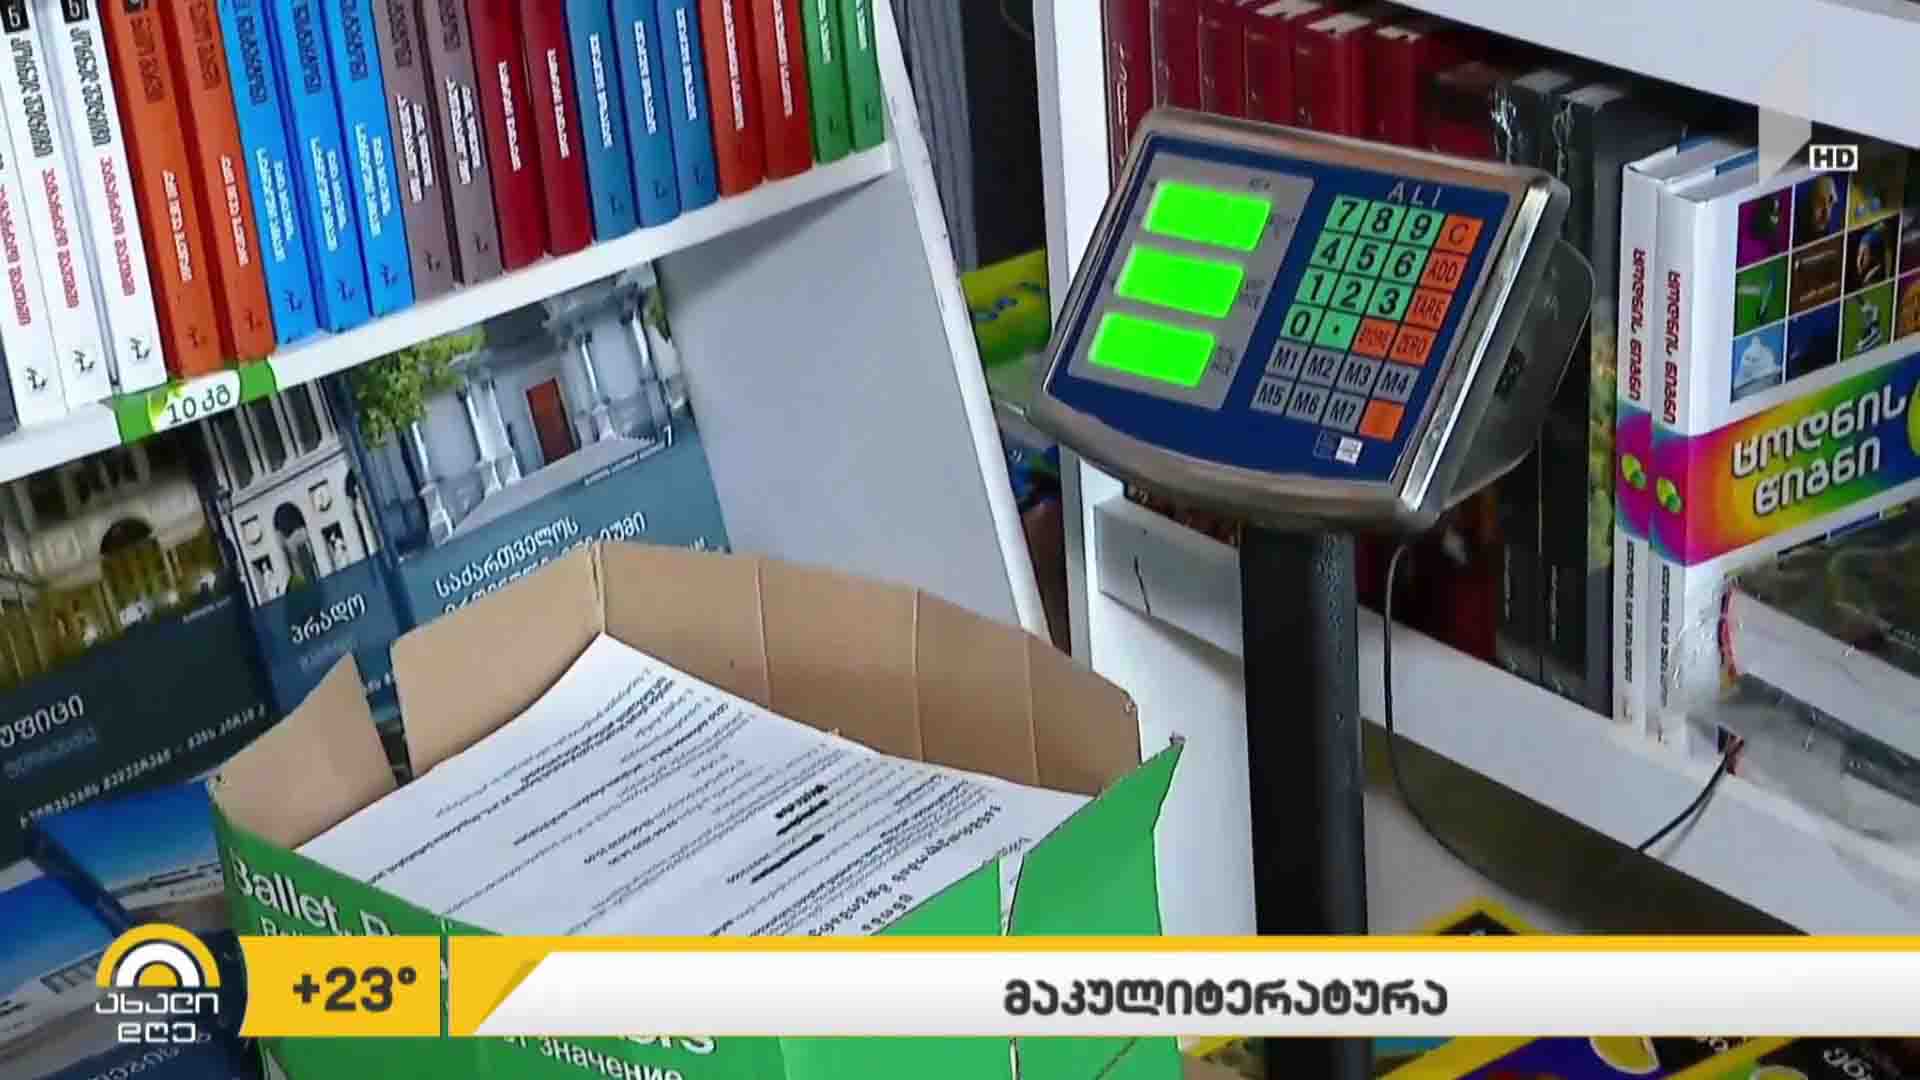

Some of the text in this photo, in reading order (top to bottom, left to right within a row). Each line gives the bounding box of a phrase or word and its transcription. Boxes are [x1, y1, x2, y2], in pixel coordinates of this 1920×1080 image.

[1386, 181, 1442, 209] ALI
[1338, 201, 1470, 246] 7 8 9 C
[1320, 238, 1341, 265] 4
[1357, 243, 1379, 271] 5
[1393, 251, 1416, 278] 6
[1310, 273, 1323, 301] 1
[1341, 280, 1361, 308] 2
[1378, 288, 1399, 315] 3
[1289, 311, 1311, 337] 0
[1629, 248, 1646, 402] ცოდნის წიგნი
[1664, 270, 1681, 425] ცოდნის წიგნი
[1272, 346, 1409, 394] M1 M2 M3 M4
[1258, 382, 1357, 423] M5 M6 M7
[1732, 383, 1907, 477] ცოდნის
[1754, 435, 1881, 516] წიგნი
[434, 515, 579, 598] საქართველოს
[290, 592, 366, 644] პრადო
